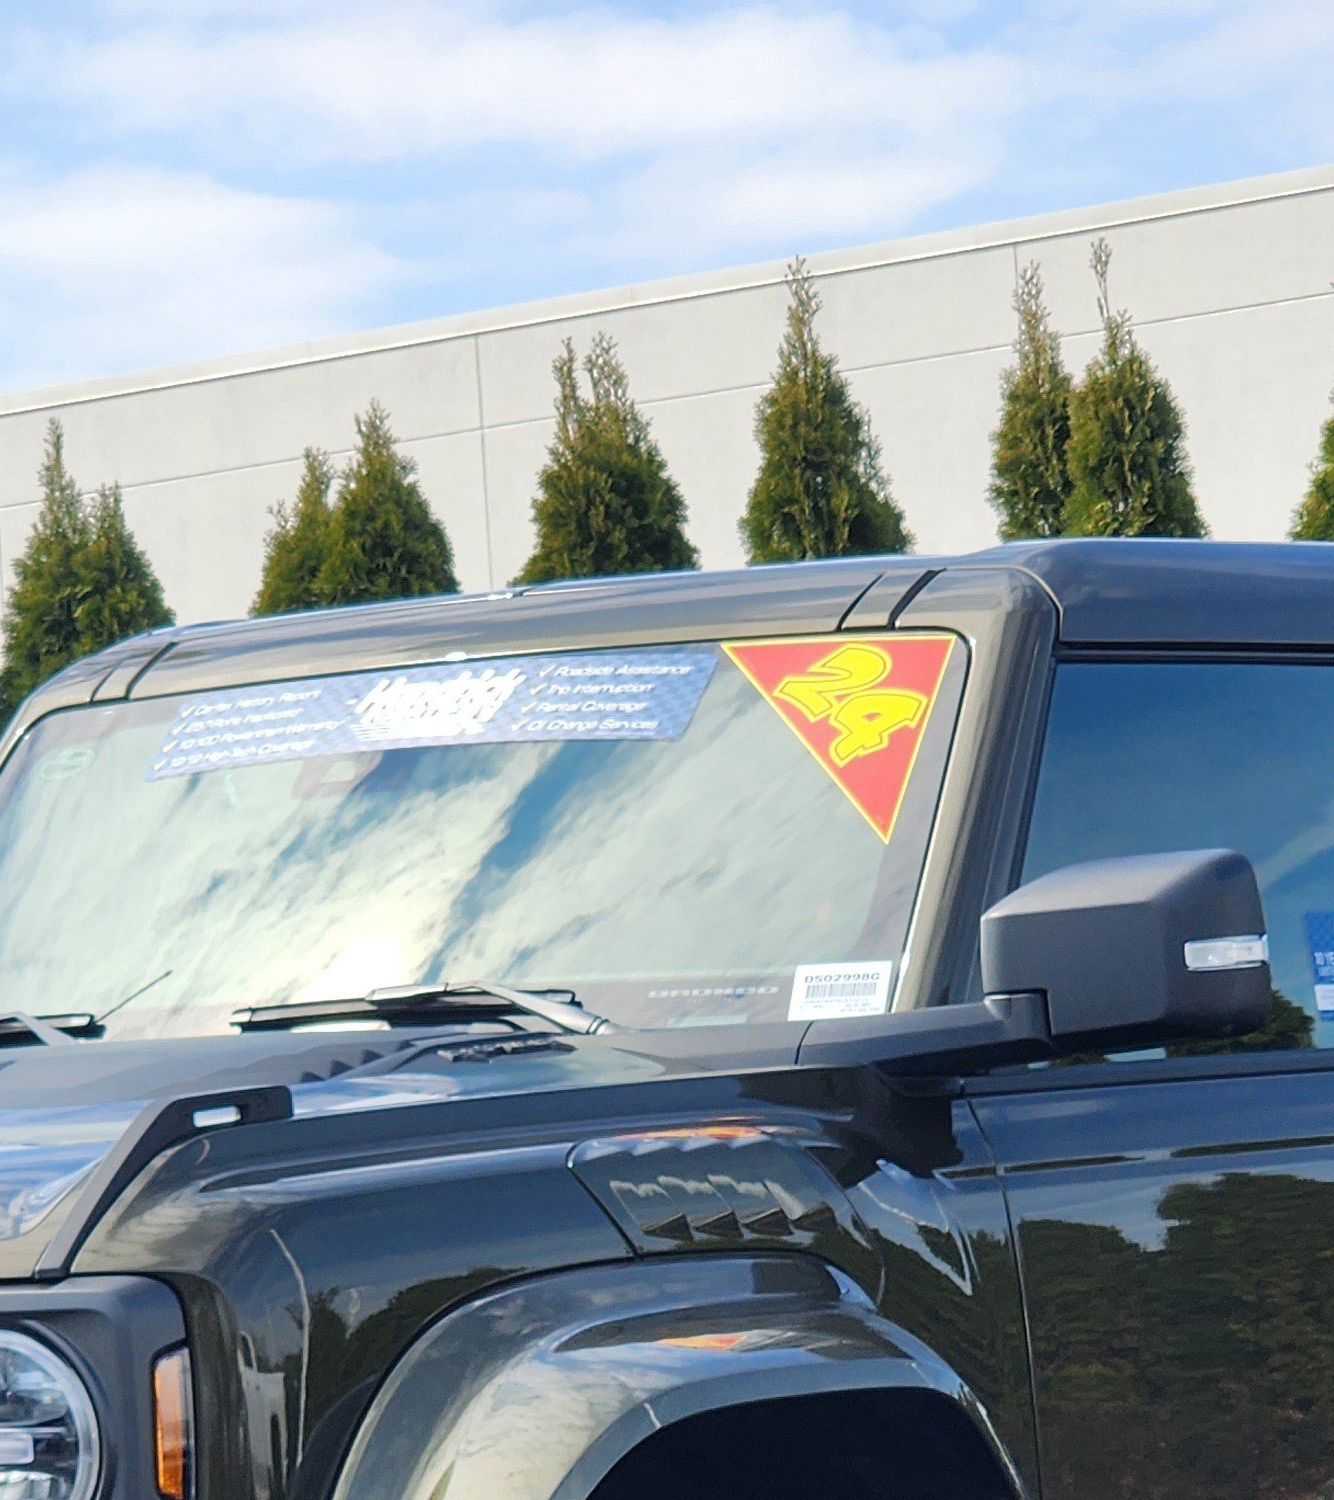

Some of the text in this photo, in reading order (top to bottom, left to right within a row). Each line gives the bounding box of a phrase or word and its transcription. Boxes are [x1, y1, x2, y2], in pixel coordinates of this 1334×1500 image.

[555, 664, 695, 677] Roadside Assistance
[572, 683, 656, 695] Interruption
[536, 701, 649, 713] Rental Coverage
[772, 642, 929, 769] 24
[547, 718, 599, 732] Change
[598, 718, 660, 731] Services
